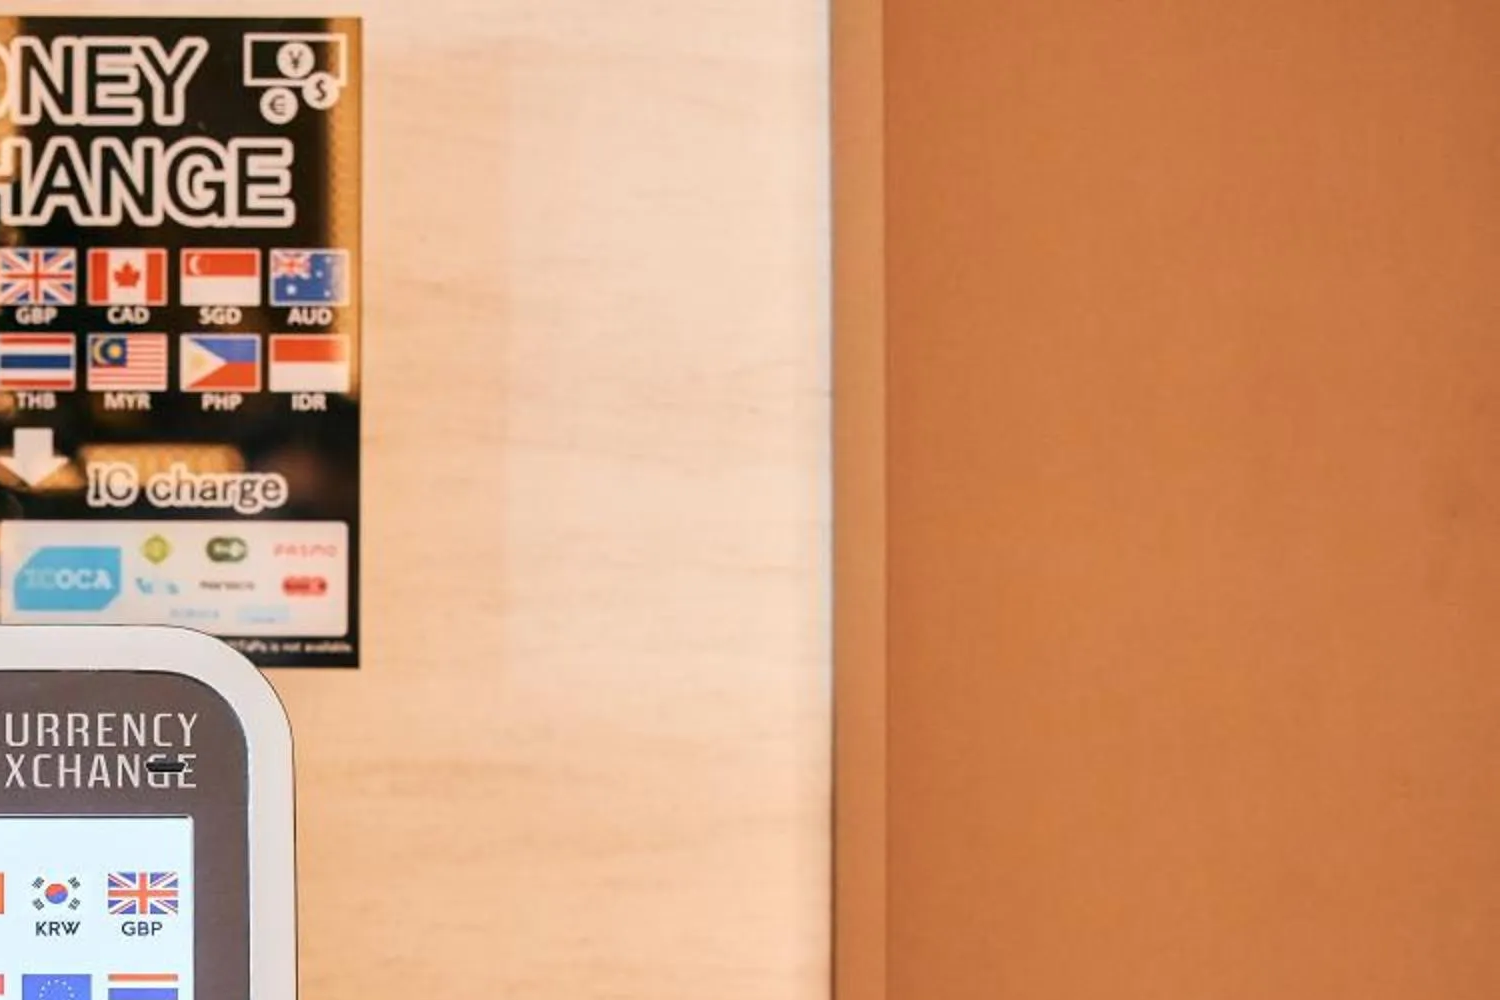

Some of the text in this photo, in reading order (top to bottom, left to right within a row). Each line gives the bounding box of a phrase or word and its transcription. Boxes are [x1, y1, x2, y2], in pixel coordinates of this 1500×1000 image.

[15, 307, 57, 325] GBP
[107, 307, 150, 325] CAD
[199, 307, 242, 325] SGD
[287, 307, 333, 325] AUD
[17, 392, 56, 409] THB
[104, 393, 150, 410] MYR
[201, 393, 243, 411] PHP
[291, 393, 327, 411] IDR
[88, 462, 288, 514] IC charge
[35, 921, 80, 937] KRW
[121, 921, 163, 937] GBP
